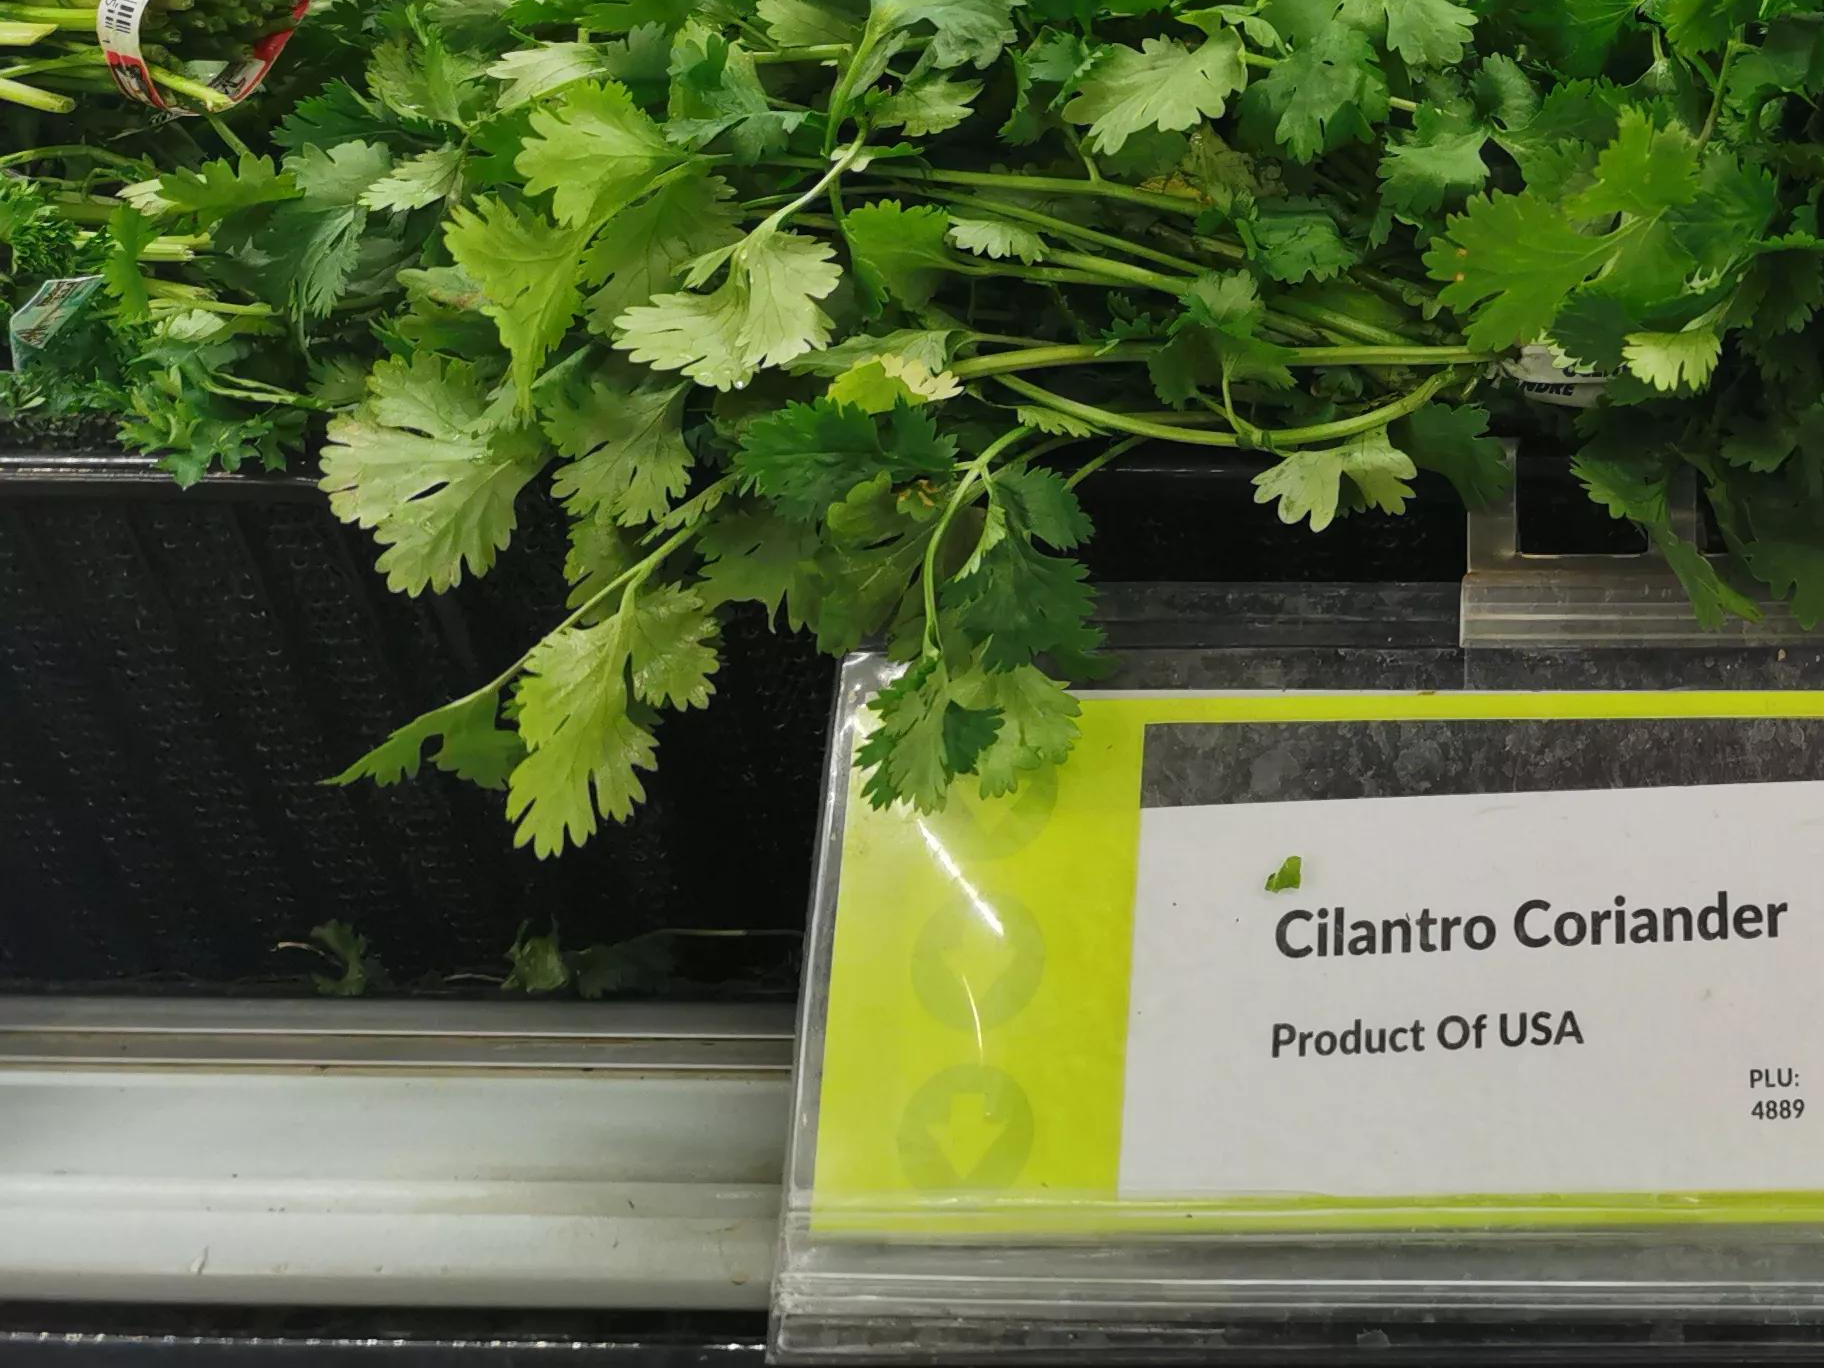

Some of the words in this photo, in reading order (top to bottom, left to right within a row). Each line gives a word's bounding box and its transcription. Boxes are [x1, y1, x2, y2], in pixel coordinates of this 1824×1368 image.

[1275, 906, 1497, 959] Cilantro
[1513, 890, 1789, 948] Coriander
[1271, 1018, 1426, 1059] Product
[1436, 1012, 1488, 1051] Of
[1499, 1009, 1585, 1048] USA
[1749, 1067, 1800, 1089] PLU:
[1750, 1098, 1806, 1121] 4889
